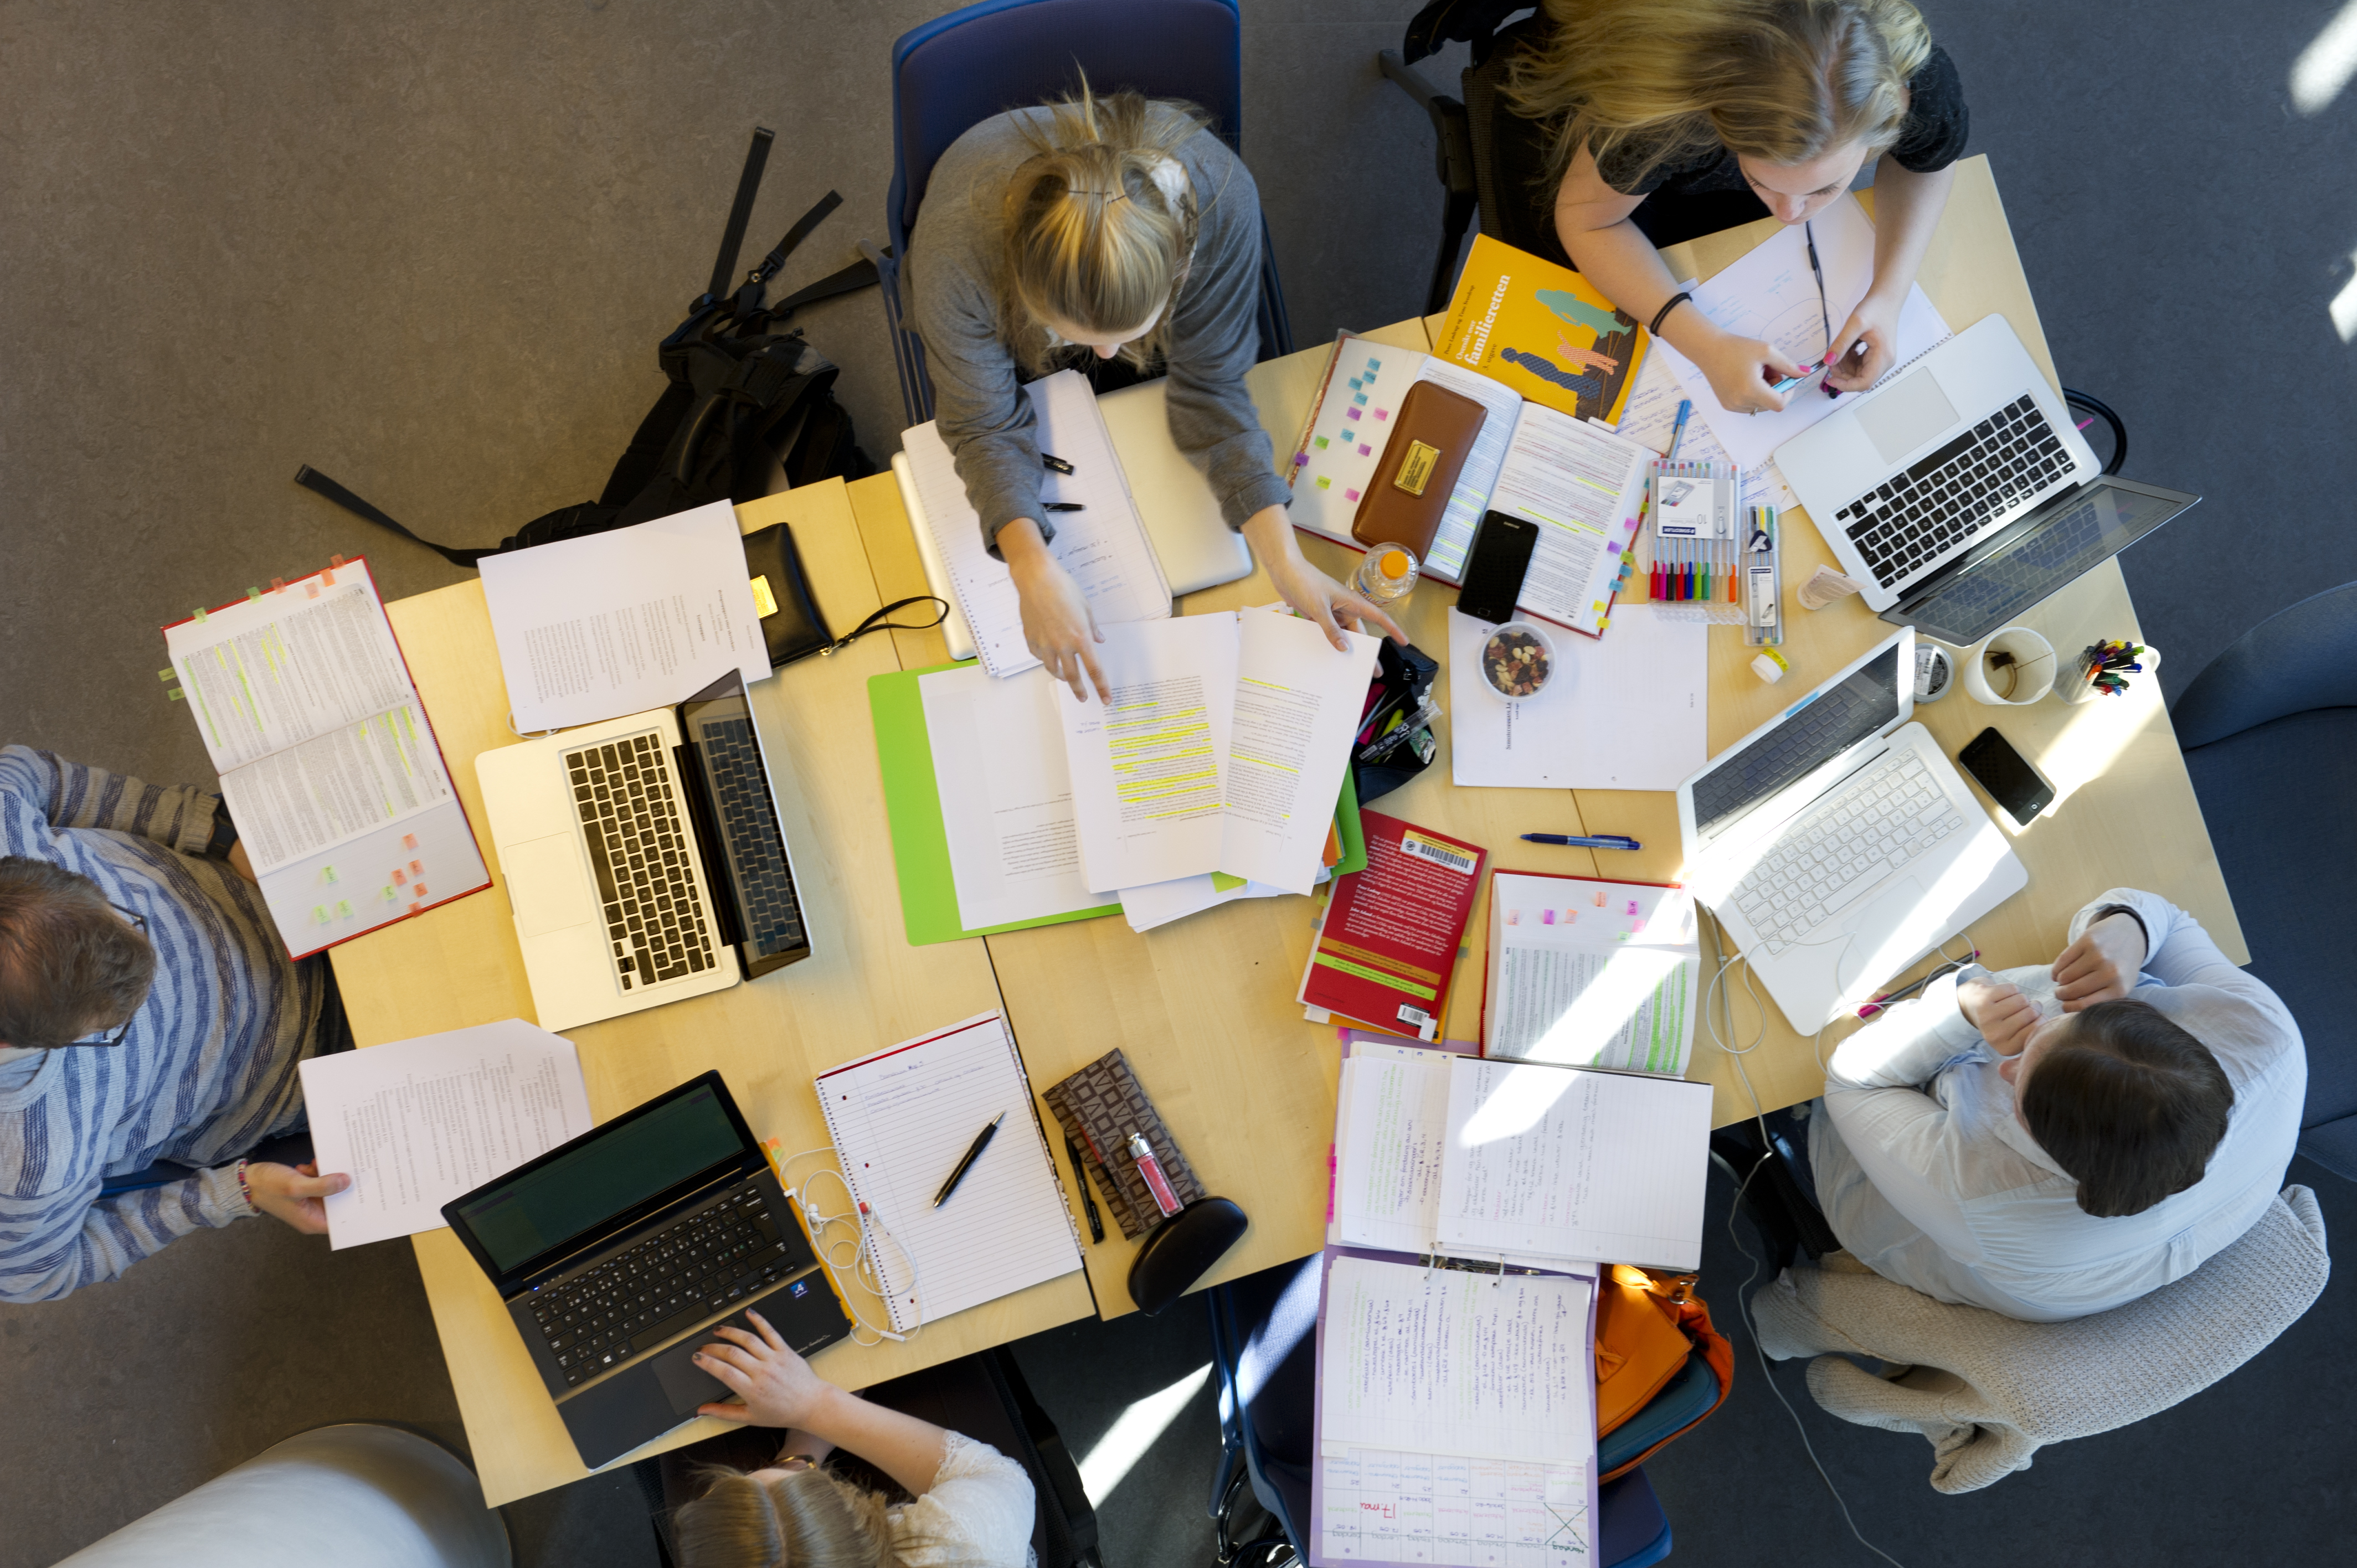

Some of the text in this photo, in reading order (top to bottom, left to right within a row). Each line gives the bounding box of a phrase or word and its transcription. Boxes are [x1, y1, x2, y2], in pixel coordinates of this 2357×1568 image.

[1465, 274, 1511, 365] familieretten
[1444, 342, 1453, 354] Peter
[1455, 320, 1476, 360] Oversikt over
[1488, 343, 1499, 364] utgave
[1696, 514, 1707, 524] 10
[1360, 1502, 1395, 1518] 17. mai
